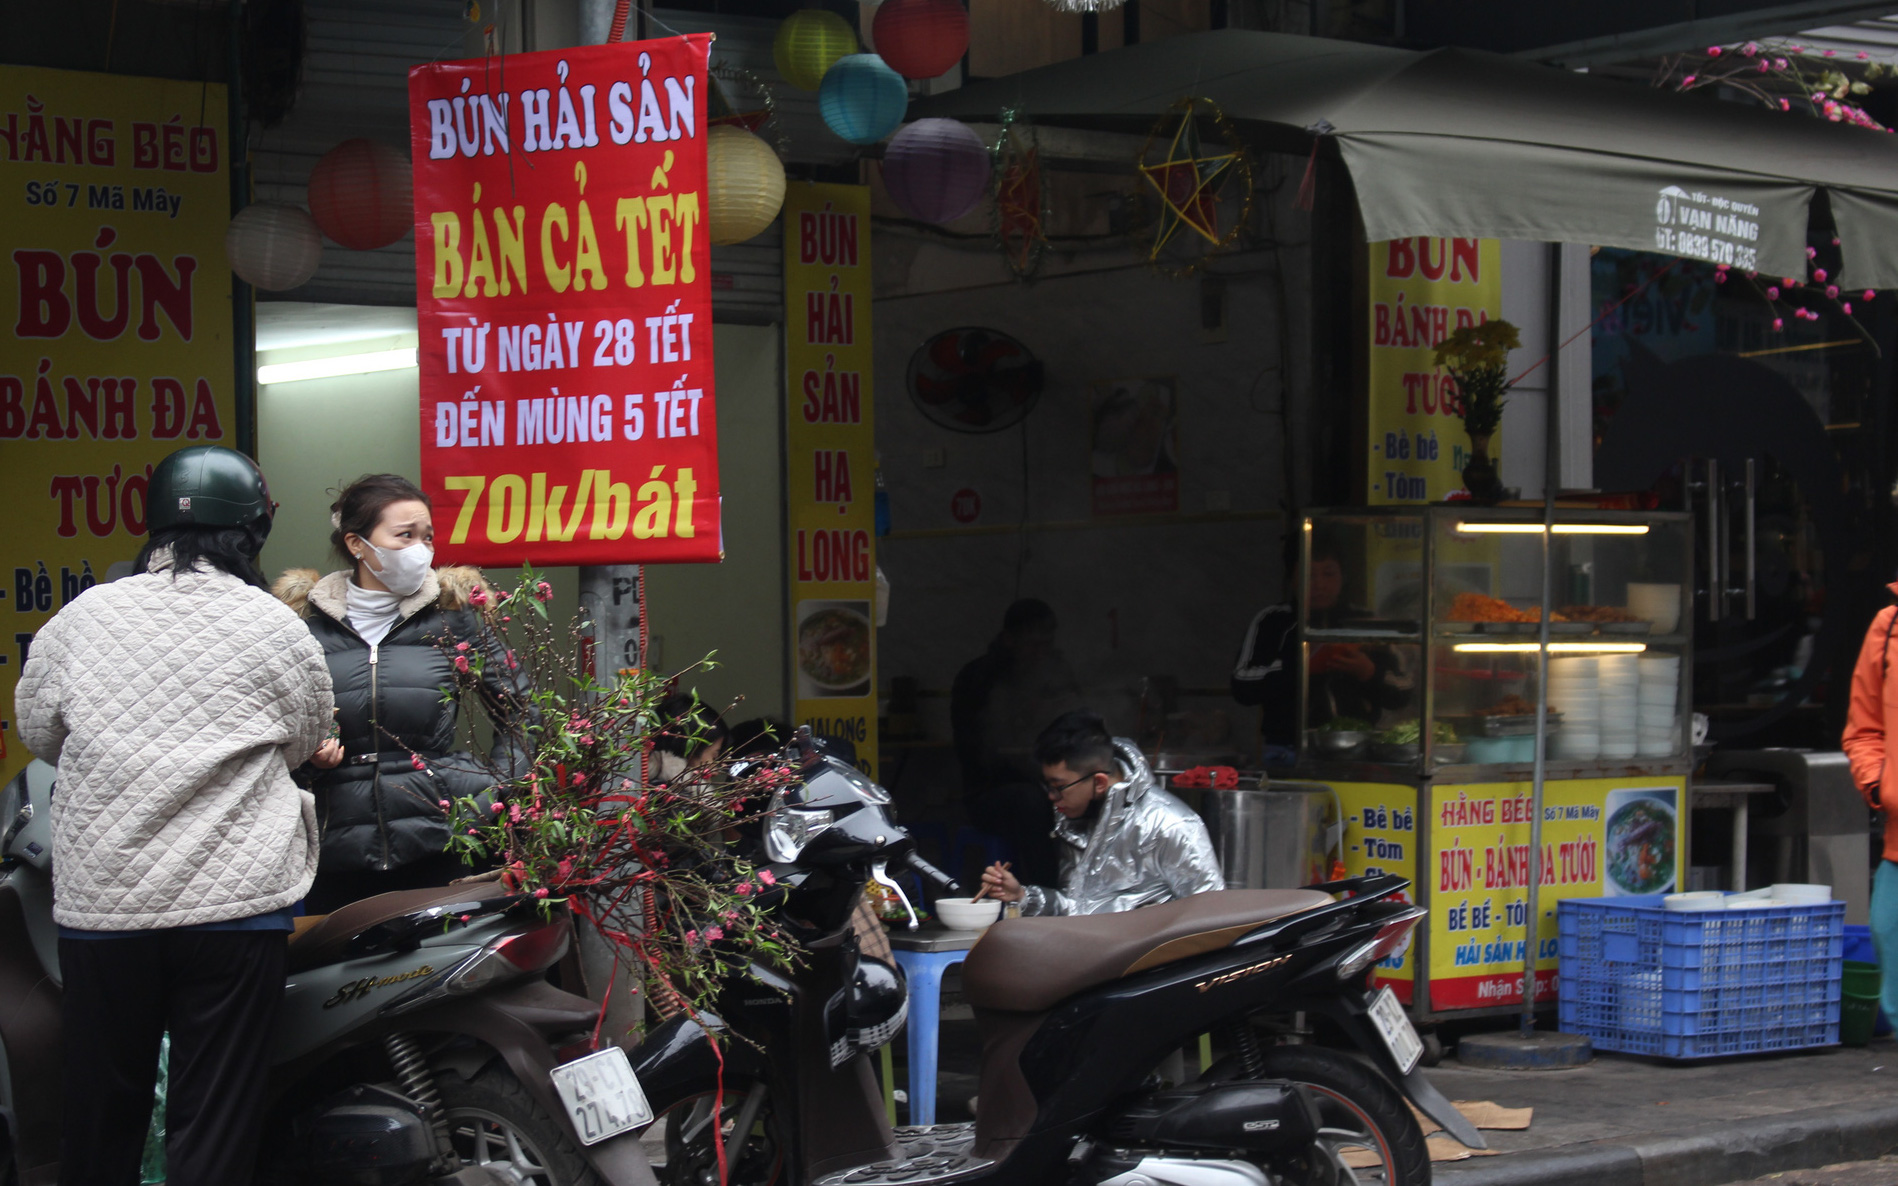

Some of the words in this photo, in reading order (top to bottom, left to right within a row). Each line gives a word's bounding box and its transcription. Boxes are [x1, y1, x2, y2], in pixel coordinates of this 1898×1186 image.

[428, 77, 509, 160] BÚN
[521, 59, 599, 153] HẢI
[608, 51, 695, 145] SẢN
[132, 114, 219, 173] BÉO
[26, 180, 59, 206] Số
[65, 184, 80, 207] 7
[88, 185, 125, 210] Mã
[132, 187, 182, 219] Mây
[431, 181, 527, 299] BÁN
[541, 160, 608, 293] CẢ
[616, 150, 699, 288] TẾT
[1680, 206, 1712, 231] VẠN
[800, 202, 857, 266] BÚN
[13, 226, 197, 343] BÚN
[807, 275, 853, 344] HẢI
[442, 317, 491, 374] TỪ
[498, 313, 584, 373] NGÀY
[593, 318, 635, 367] 28
[645, 298, 694, 364] TẾT
[0, 358, 138, 440] BÁNH
[152, 377, 223, 439] ĐA
[435, 385, 505, 447] ĐẾN
[516, 387, 612, 445] MÙNG
[623, 393, 644, 441] 5
[654, 373, 703, 439] TẾT
[803, 354, 860, 423] SẢN
[51, 464, 149, 537] TƯƠ
[445, 464, 697, 544] 70k/bát
[815, 451, 852, 514] HẠ
[1385, 472, 1426, 501] Tôm
[15, 560, 51, 612] Bề
[798, 530, 870, 582] LONG
[1441, 791, 1494, 826] HẰNG
[1544, 805, 1557, 820] Số
[1558, 806, 1564, 819] 7
[1566, 805, 1579, 819] Mã
[1364, 838, 1403, 860] Tôm
[1440, 837, 1473, 892] BÚN
[1485, 834, 1529, 889] BÁNH
[1560, 834, 1596, 883] TƯƠI
[1195, 954, 1293, 993] VISION
[1455, 937, 1481, 965] HẢI
[1484, 935, 1512, 963] SẢN
[1477, 980, 1512, 1002] Nhận
